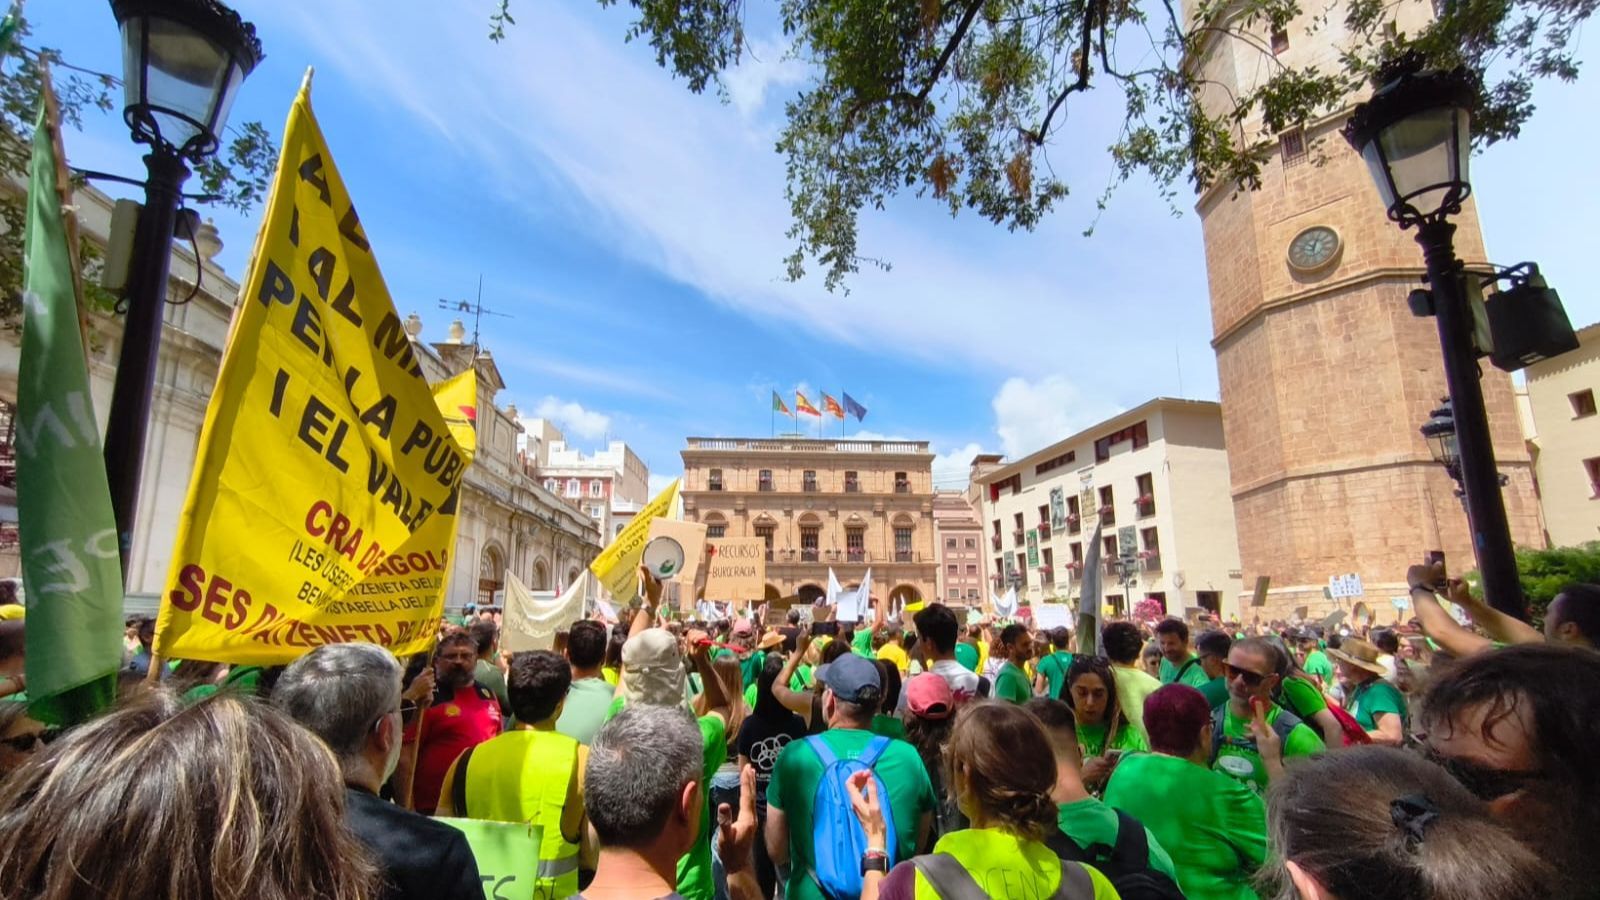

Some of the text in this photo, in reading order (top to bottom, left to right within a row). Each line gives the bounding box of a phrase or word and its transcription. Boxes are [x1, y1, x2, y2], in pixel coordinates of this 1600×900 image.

[269, 368, 290, 418] I
[297, 394, 350, 474] EL
[304, 500, 364, 563] CRA
[718, 543, 760, 558] RECURSOS
[169, 563, 252, 631] SES
